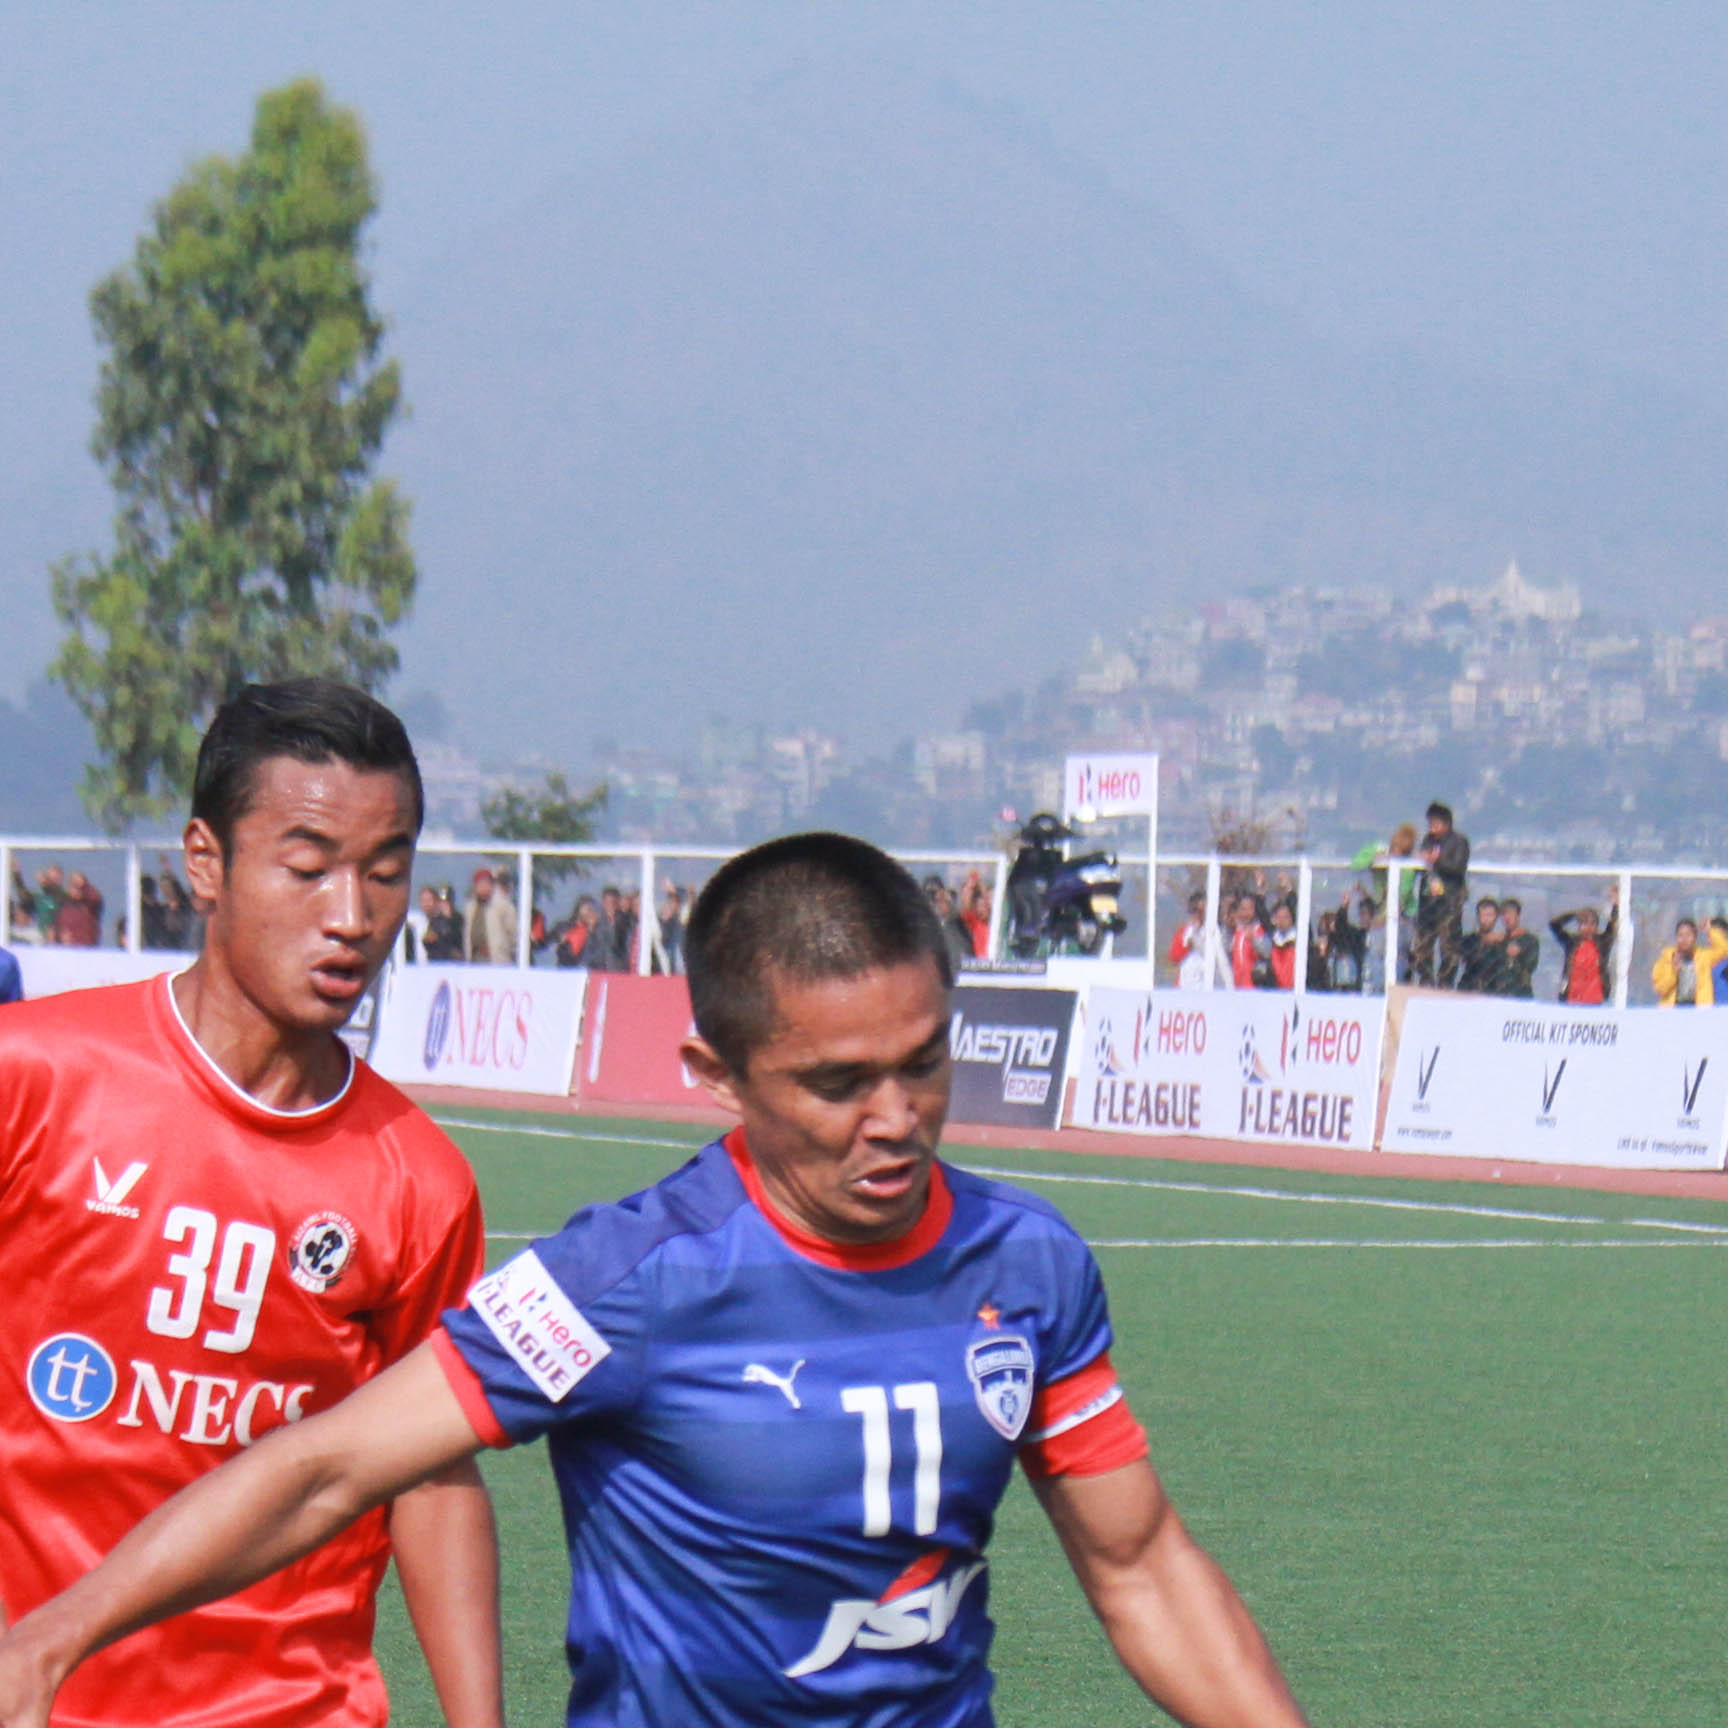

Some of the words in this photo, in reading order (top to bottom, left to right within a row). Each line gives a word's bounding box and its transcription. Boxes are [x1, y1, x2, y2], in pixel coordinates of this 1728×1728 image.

[1099, 770, 1141, 799] Hero
[446, 988, 532, 1070] NECS
[1158, 1009, 1207, 1055] Hero
[1306, 1017, 1363, 1066] Hero
[1502, 1020, 1547, 1043] OFFICIAL
[1548, 1022, 1569, 1045] KIT
[1568, 1022, 1619, 1047] SPONSOR
[1007, 1076, 1048, 1099] EDGE
[1093, 1078, 1203, 1130] I-LEAGUE
[1238, 1086, 1354, 1142] I-LEAGUE
[145, 1205, 277, 1355] 39
[539, 1310, 592, 1368] Hero
[840, 1380, 943, 1538] 11
